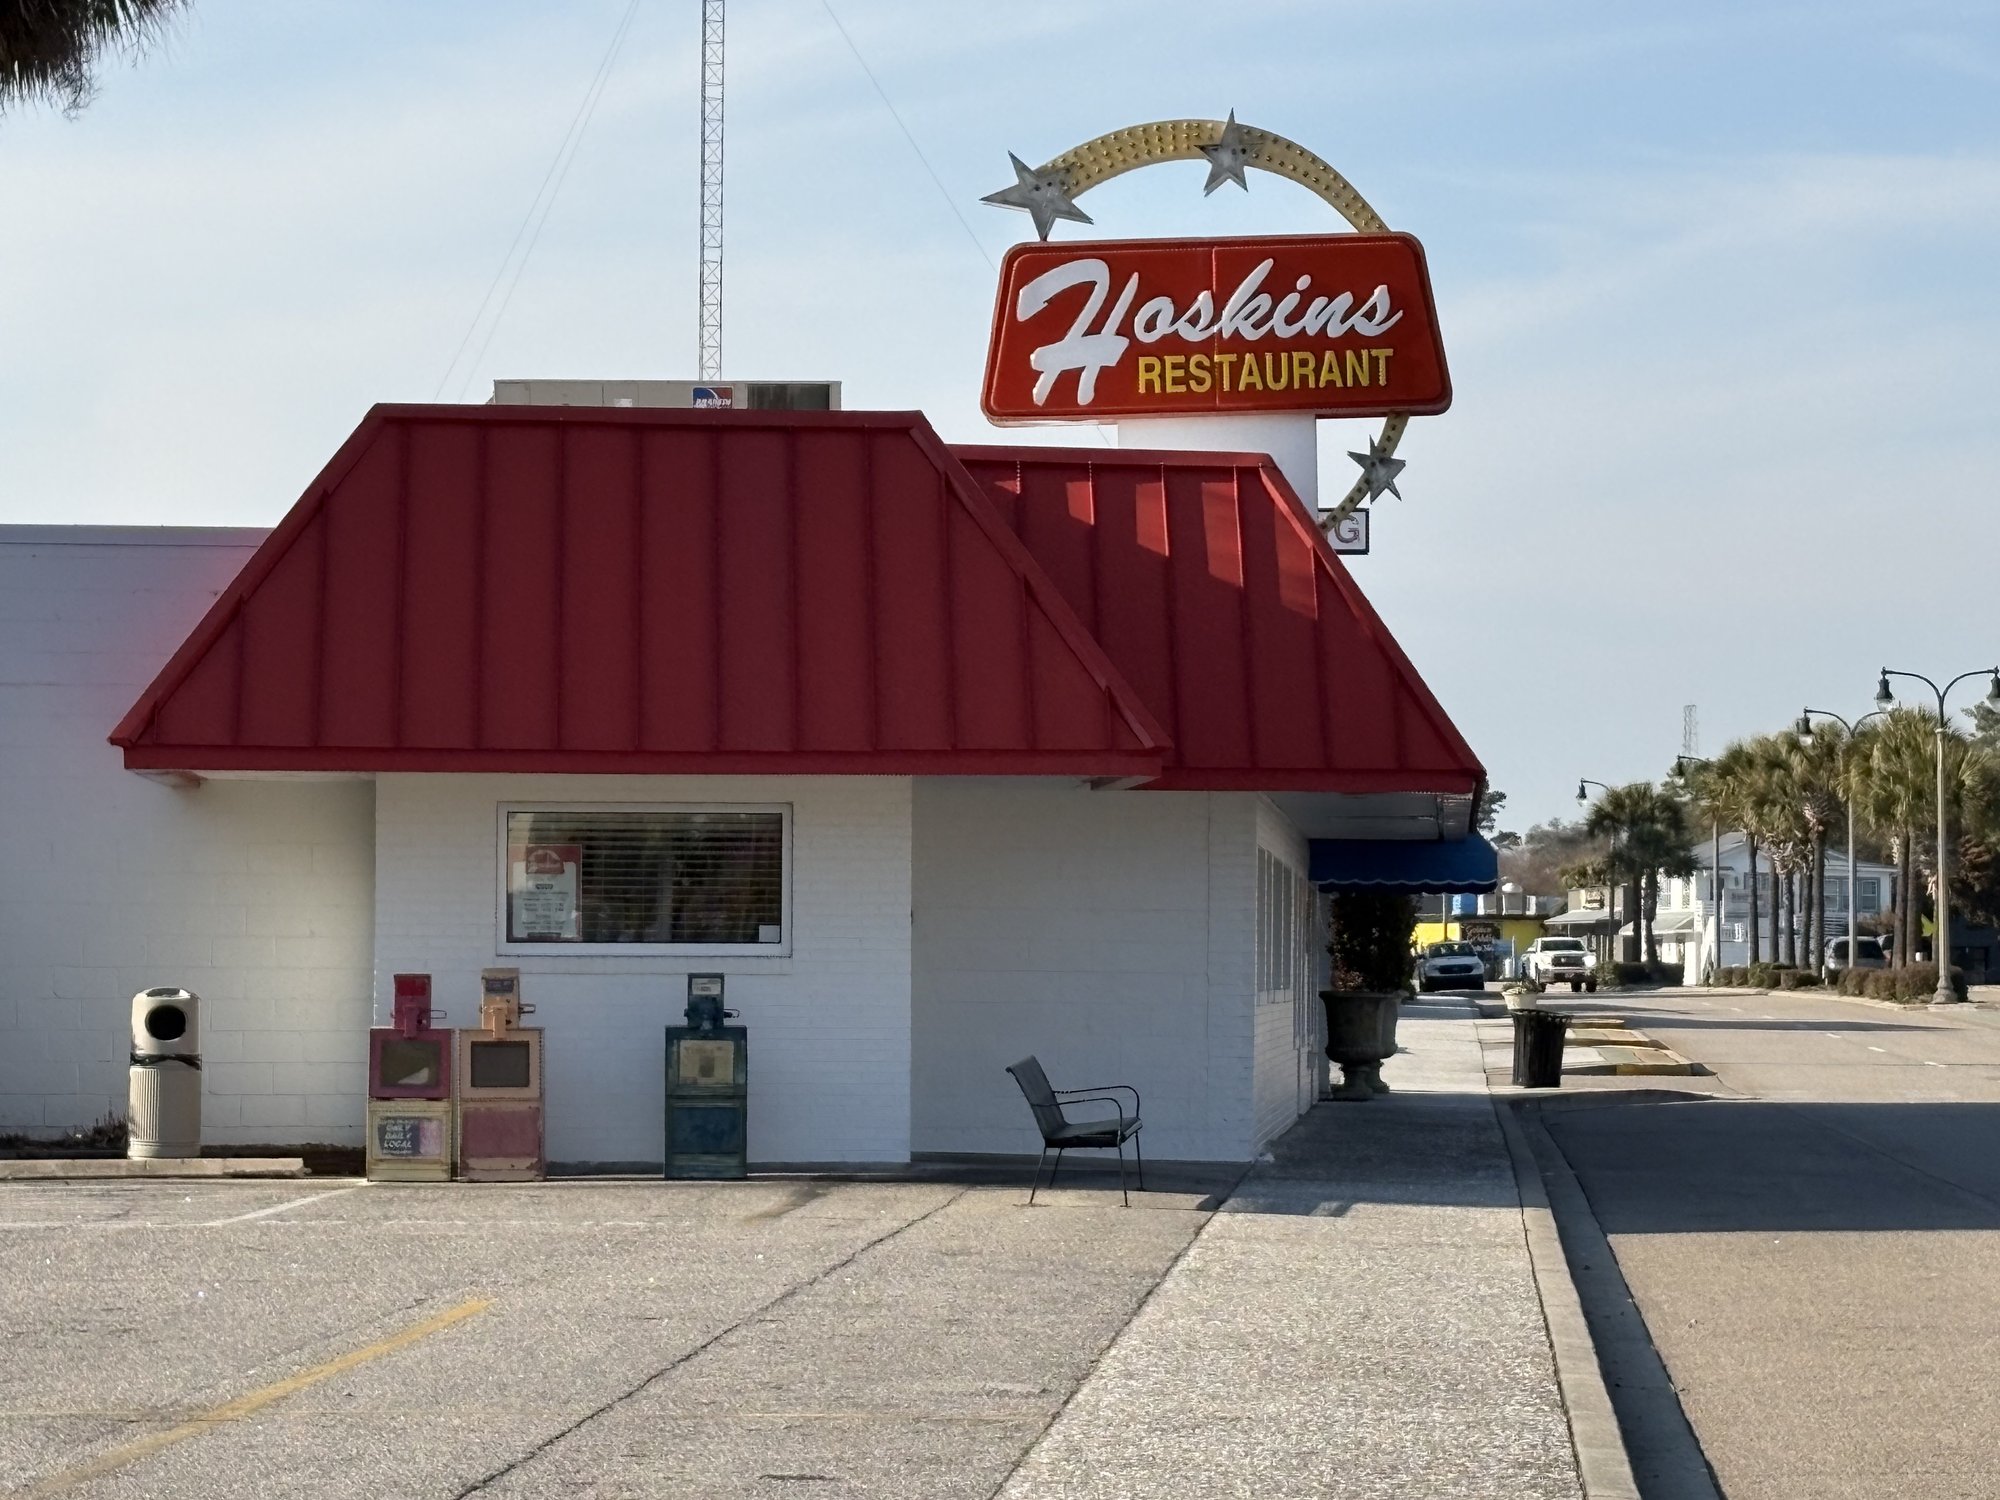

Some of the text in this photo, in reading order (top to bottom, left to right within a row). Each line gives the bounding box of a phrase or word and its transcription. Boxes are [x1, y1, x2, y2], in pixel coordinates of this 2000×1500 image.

[1016, 258, 1403, 406] Hoskins
[1138, 348, 1394, 394] RESTAURANT
[383, 1140, 412, 1148] LOCAL
